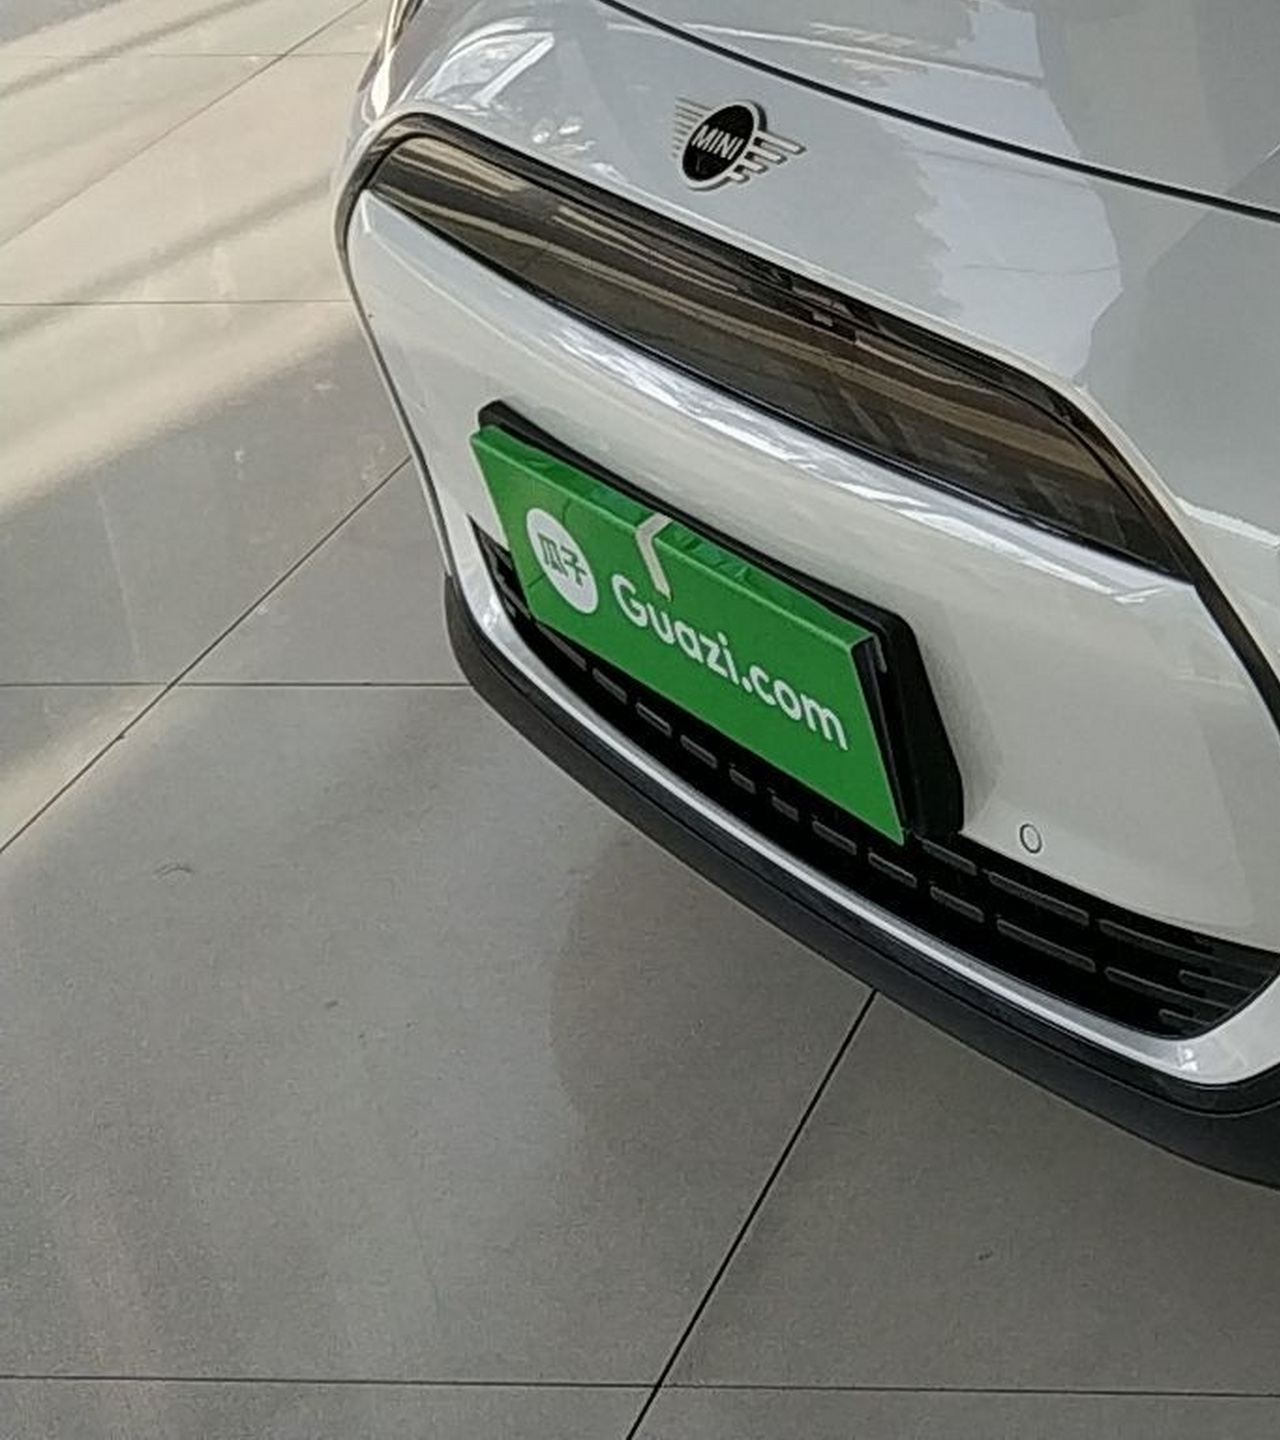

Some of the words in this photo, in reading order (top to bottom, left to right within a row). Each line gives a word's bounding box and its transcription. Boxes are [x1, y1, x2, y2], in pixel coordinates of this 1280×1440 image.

[691, 124, 744, 160] MINI
[537, 532, 588, 587] 瓜子
[611, 573, 849, 752] Guazi.com
